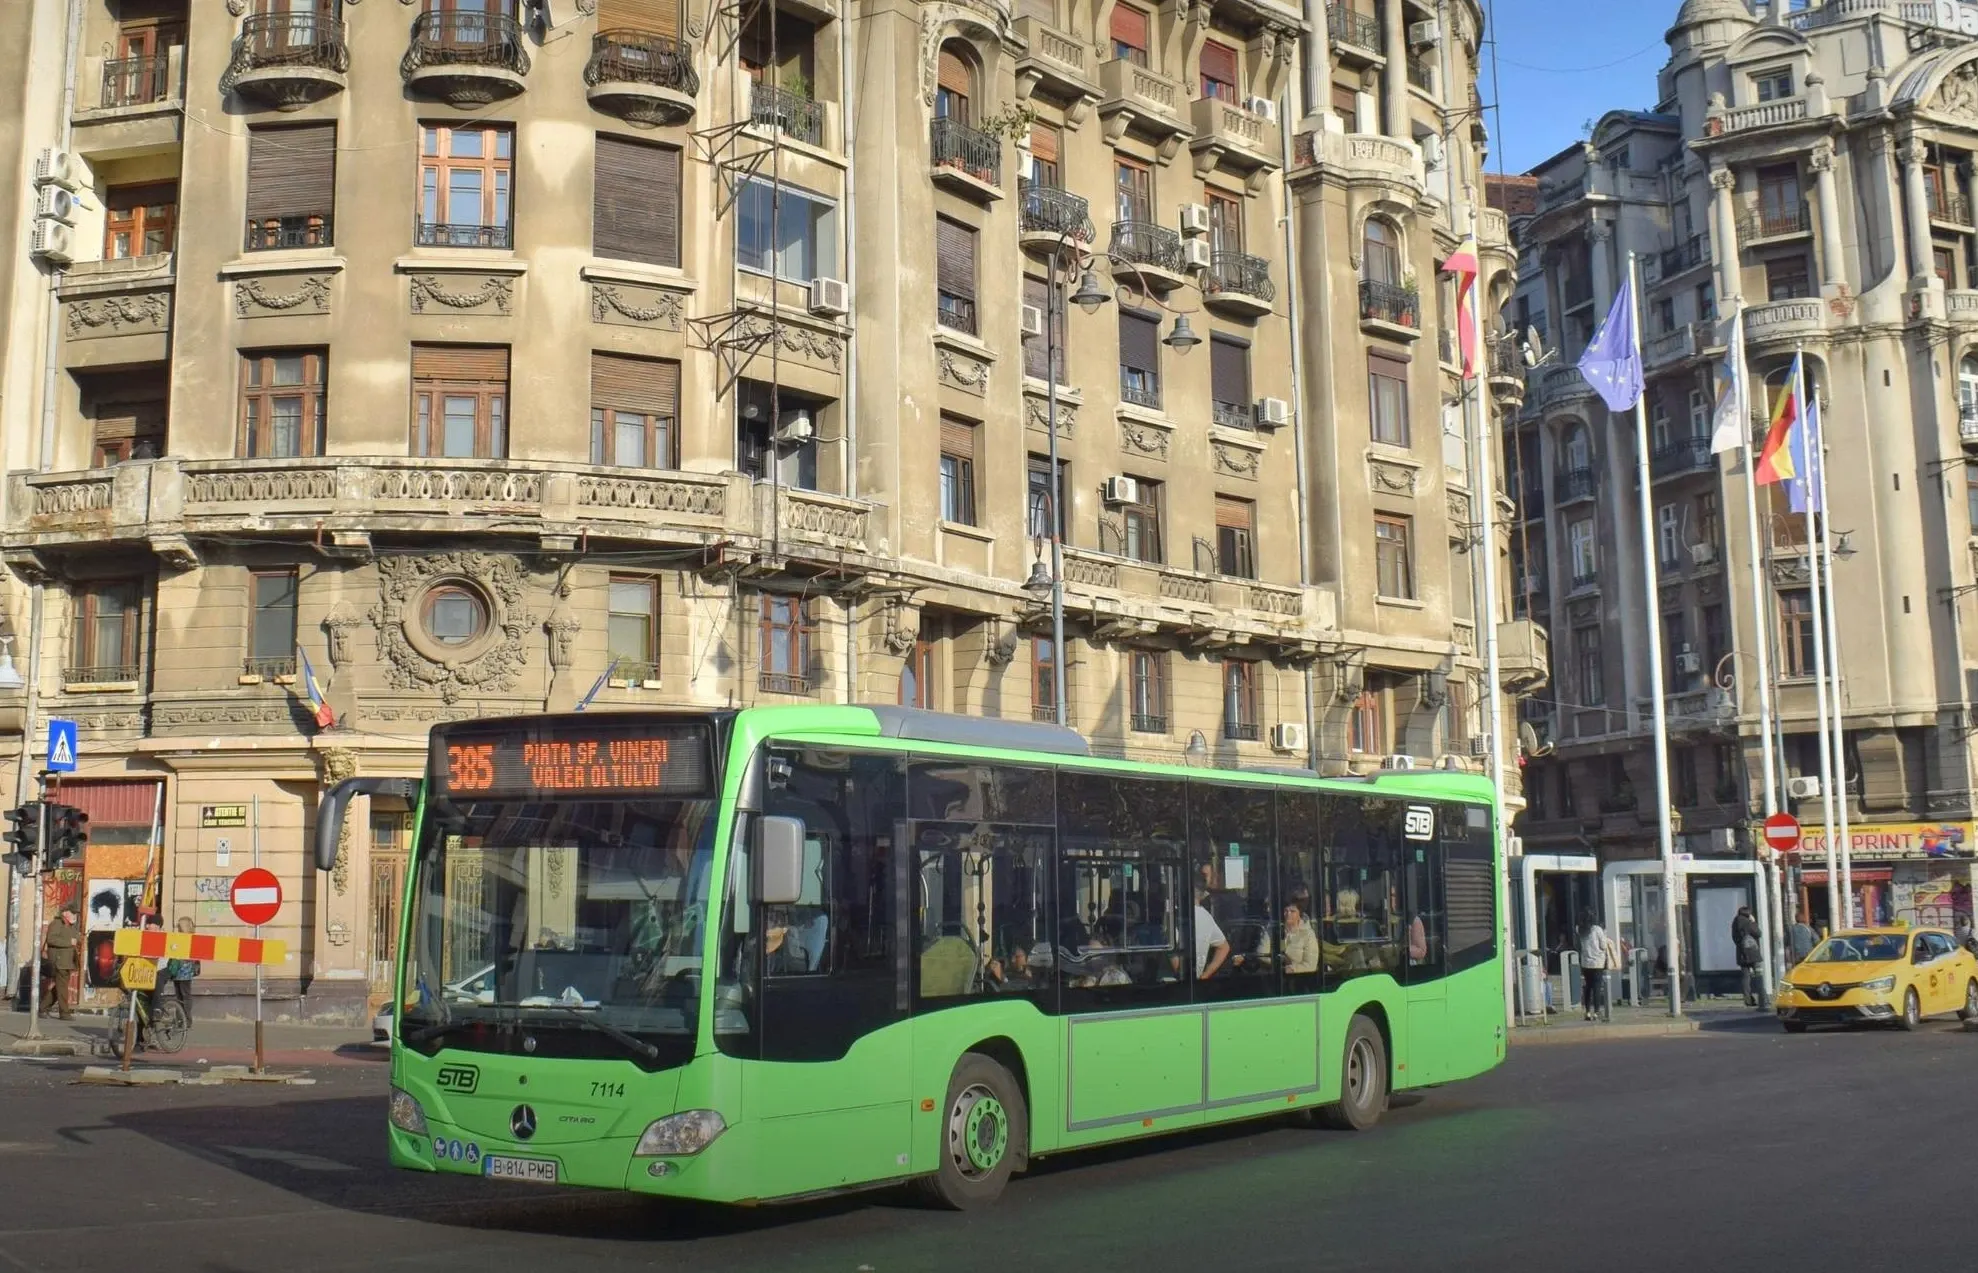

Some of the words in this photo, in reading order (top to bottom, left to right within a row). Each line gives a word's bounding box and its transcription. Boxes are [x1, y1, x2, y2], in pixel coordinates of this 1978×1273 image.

[523, 743, 572, 765] PIATA
[576, 742, 604, 764] SF.
[609, 740, 669, 763] VINERI
[447, 745, 493, 790] 385
[532, 765, 585, 788] VALEA
[590, 764, 660, 787] OLTULUI
[1404, 810, 1431, 835] STB
[1852, 833, 1914, 850] PRINT
[436, 1067, 477, 1089] STB
[590, 1081, 626, 1098] 7114
[528, 1163, 555, 1180] PMB
